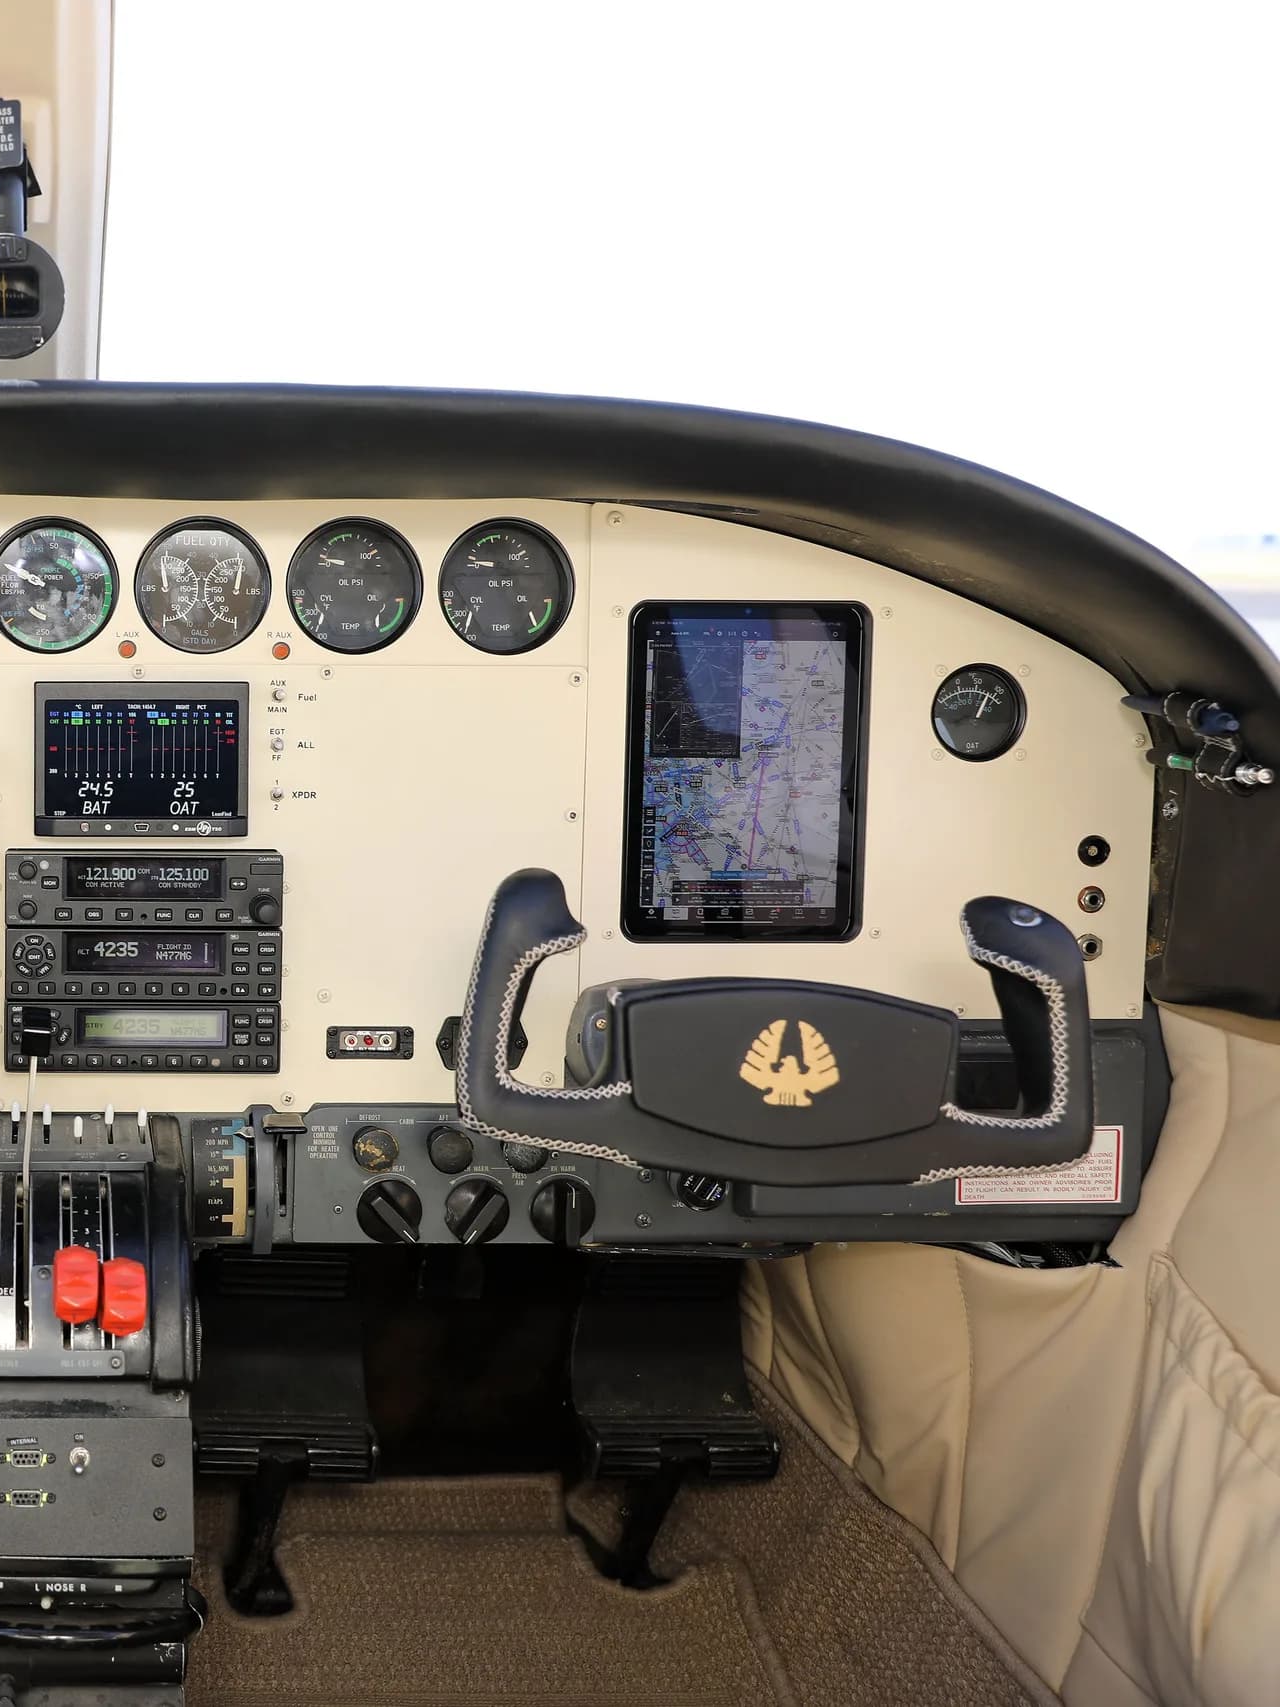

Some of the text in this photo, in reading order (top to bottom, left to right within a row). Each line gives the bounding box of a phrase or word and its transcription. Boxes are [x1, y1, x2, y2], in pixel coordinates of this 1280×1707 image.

[338, 578, 350, 586] OIL
[319, 594, 333, 602] CYL
[470, 596, 484, 604] CYL
[191, 629, 209, 637] GALS
[298, 693, 317, 701] Fuel
[297, 741, 315, 749] ALL
[78, 781, 114, 797] 24.5
[173, 781, 195, 798] 25
[292, 791, 317, 799] XPDR
[82, 801, 111, 815] BAT
[169, 801, 200, 815] OAT
[86, 867, 137, 881] 121.900
[159, 868, 209, 881] 125.100
[93, 941, 139, 957] 4235
[155, 951, 193, 961] N477MG
[10, 1437, 38, 1446] INTERNAL
[34, 1583, 87, 1593] L NOSE R
